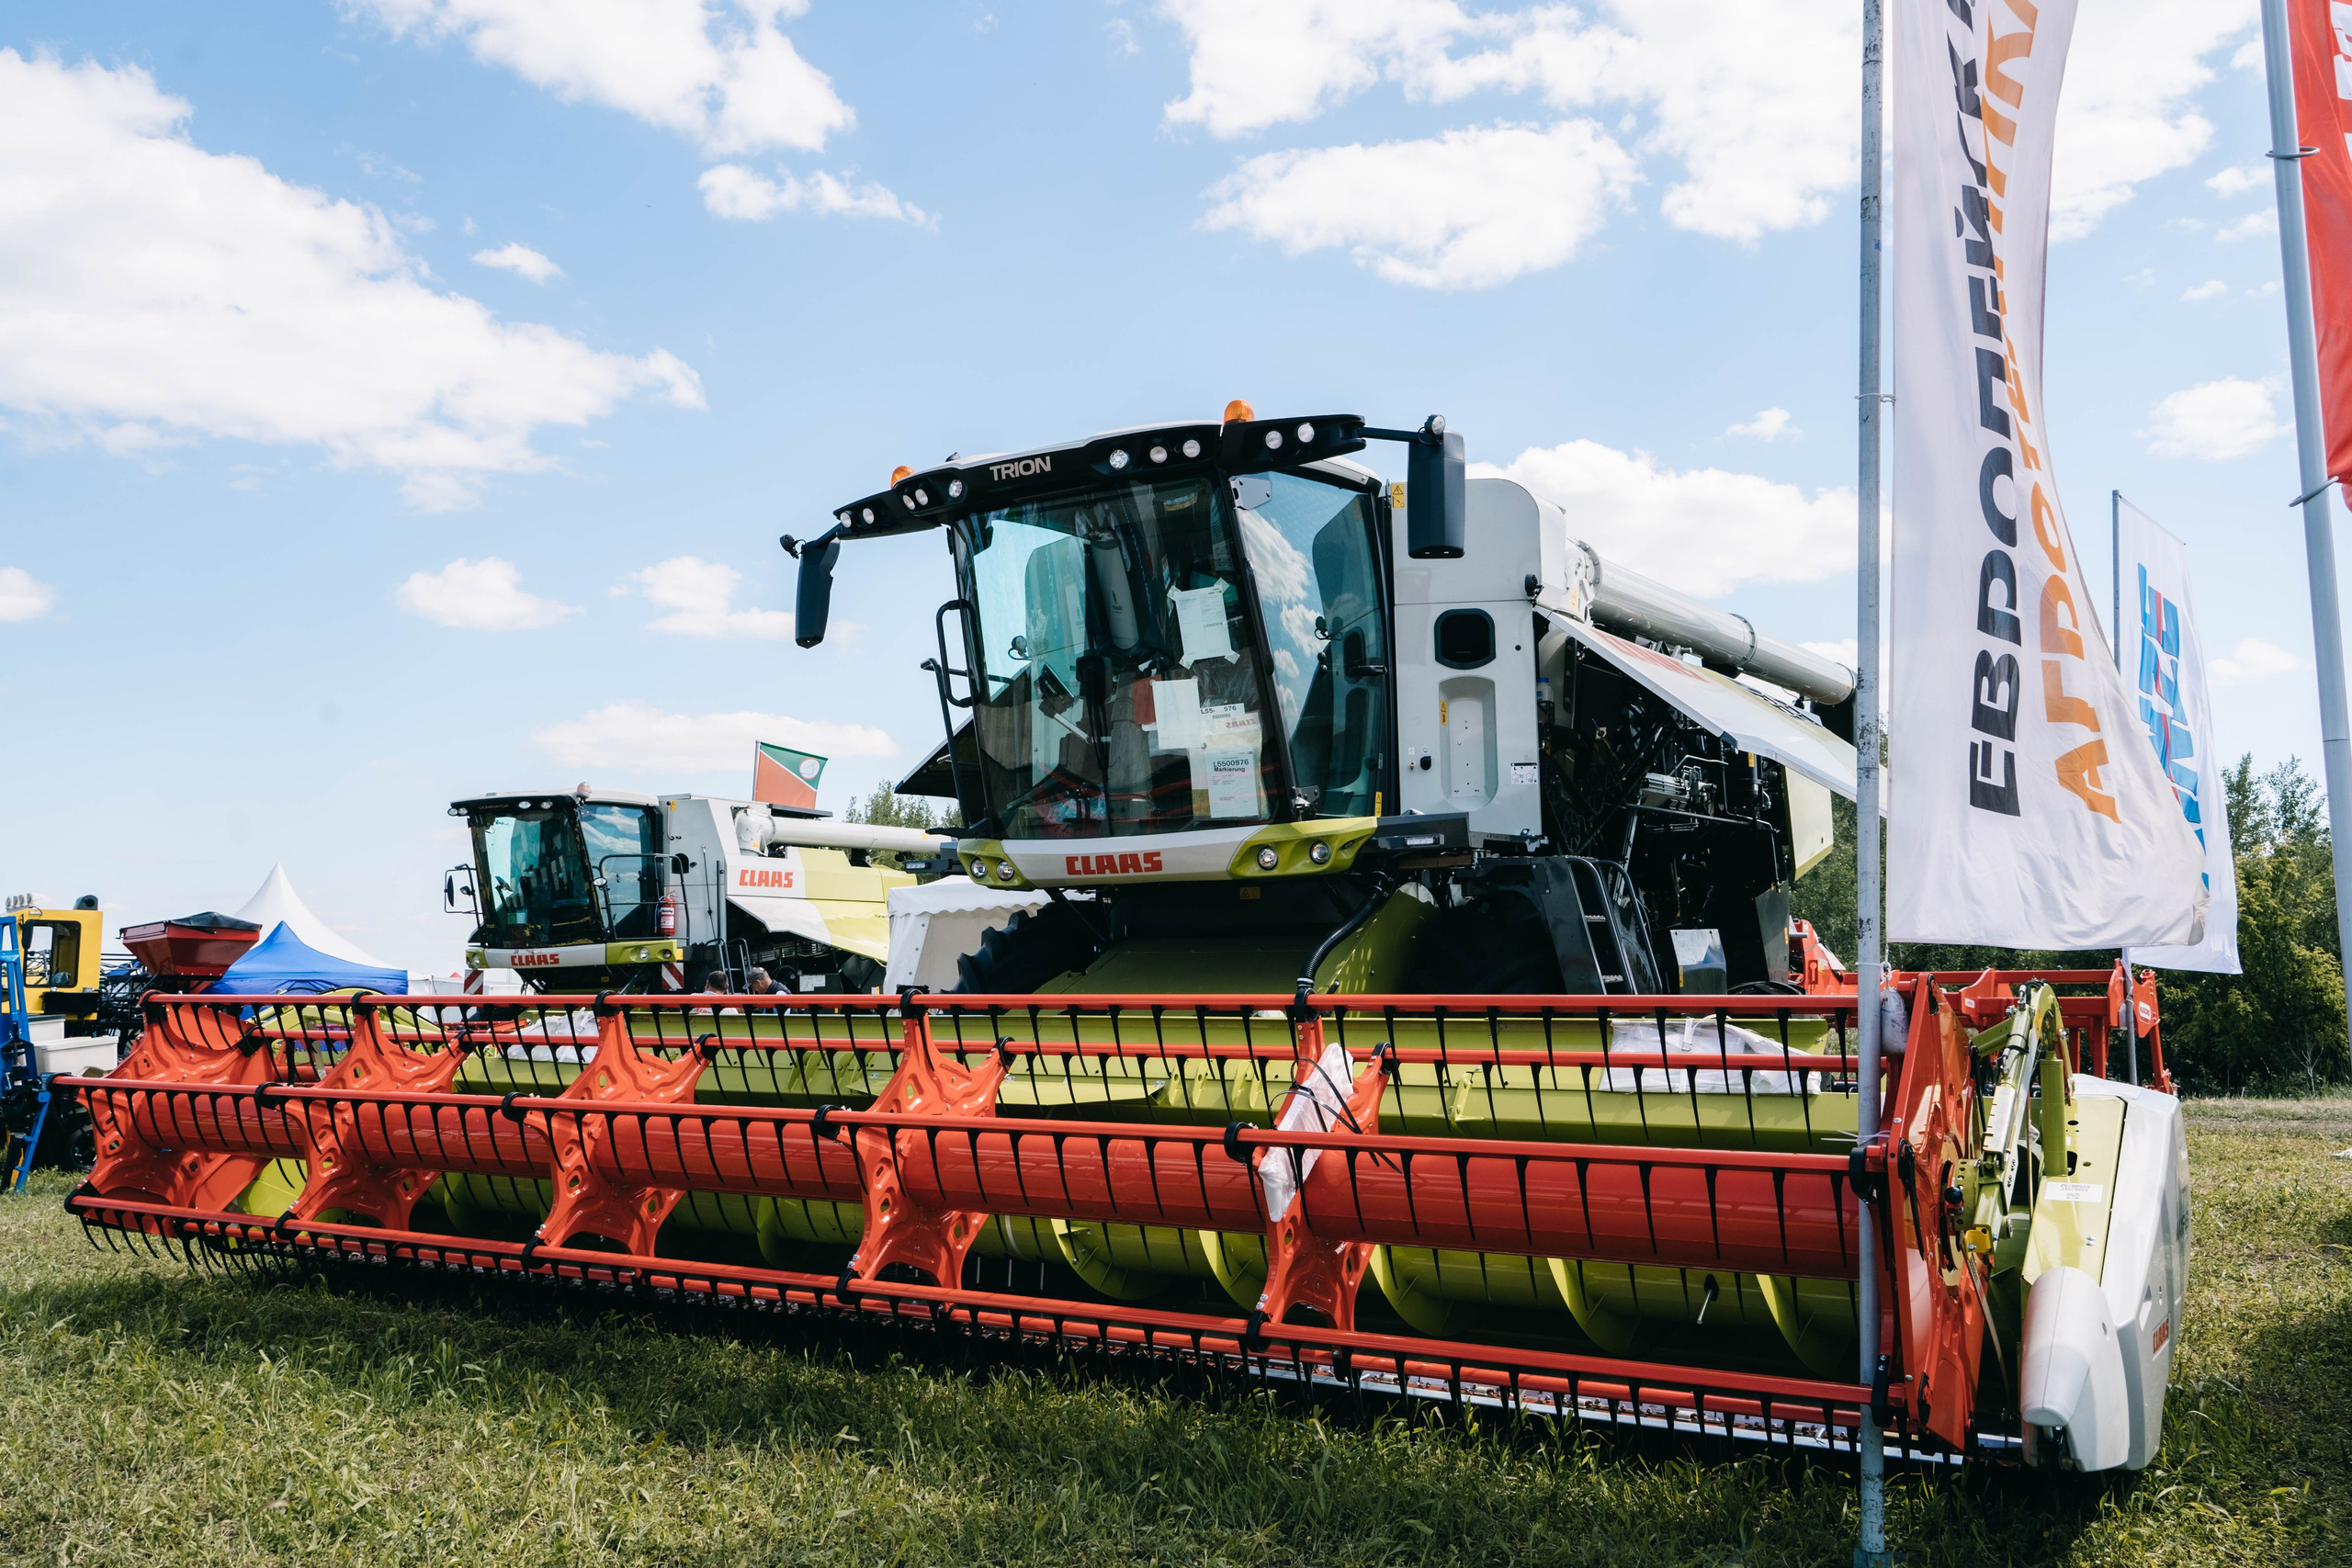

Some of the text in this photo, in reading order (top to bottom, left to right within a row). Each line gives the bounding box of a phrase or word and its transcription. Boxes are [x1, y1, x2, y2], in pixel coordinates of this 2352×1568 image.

[989, 456, 1051, 481] TRION
[1212, 759, 1250, 768] L5500976
[1214, 765, 1246, 773] Markierung
[1066, 851, 1162, 875] CLAAS
[739, 869, 794, 888] CLAAS
[510, 953, 560, 966] CLAAS
